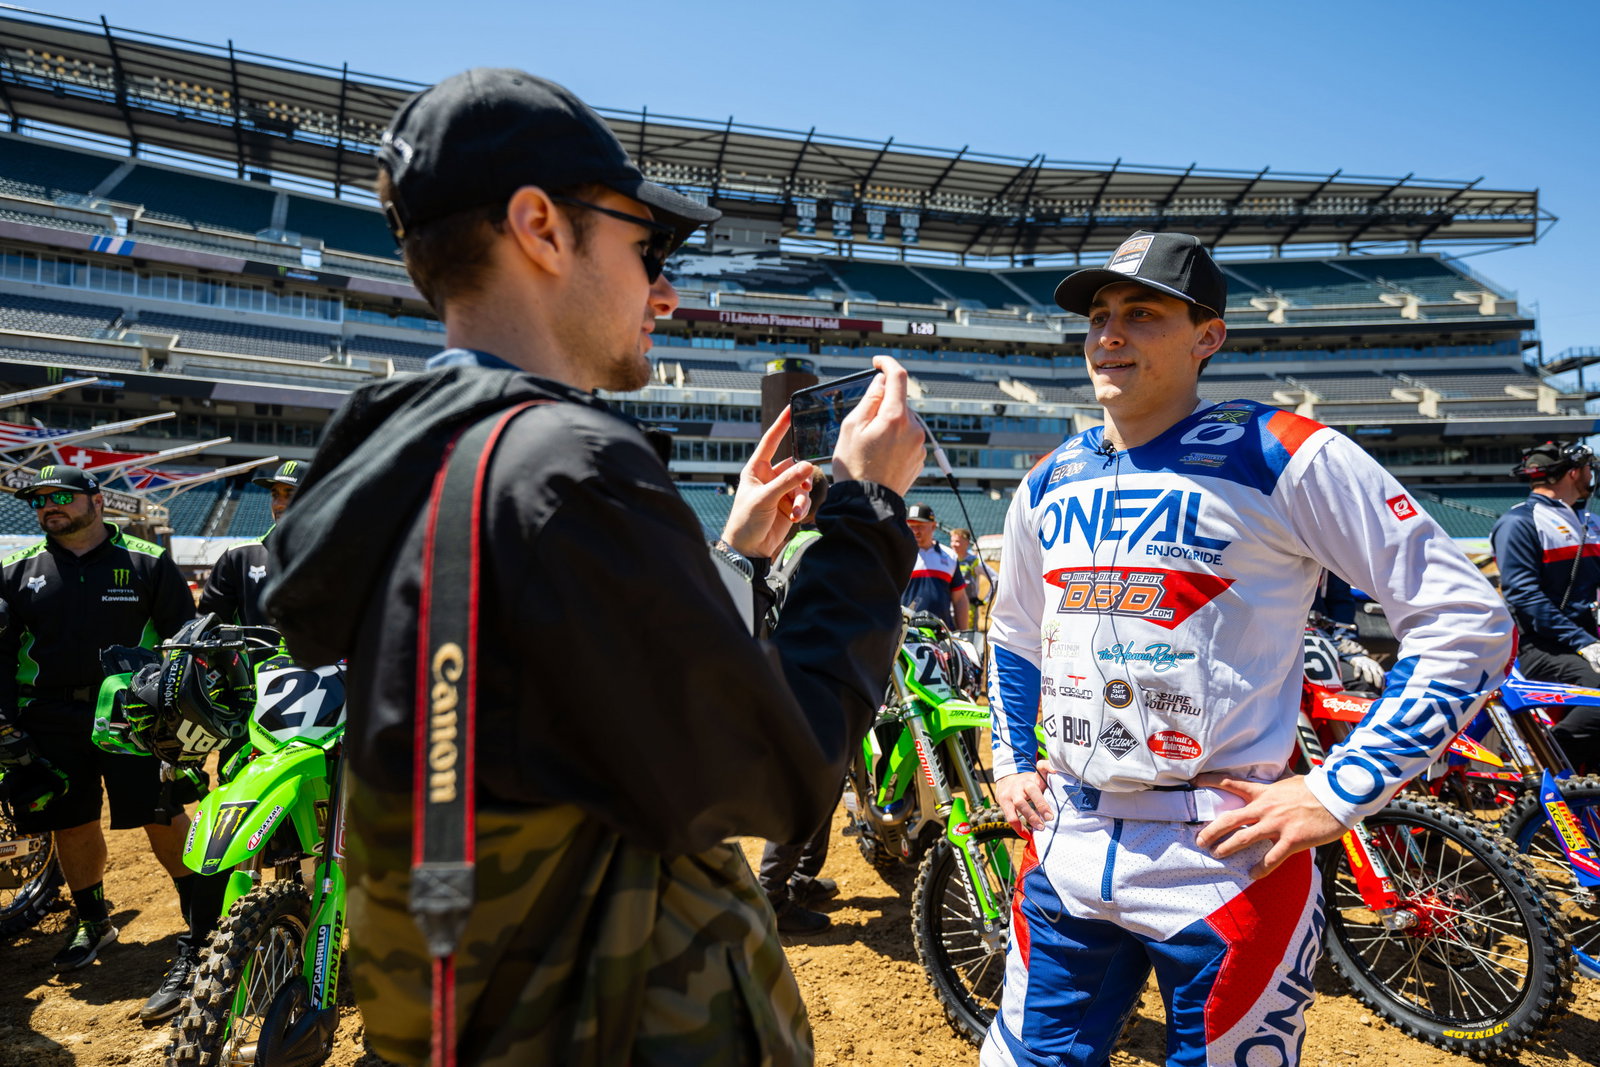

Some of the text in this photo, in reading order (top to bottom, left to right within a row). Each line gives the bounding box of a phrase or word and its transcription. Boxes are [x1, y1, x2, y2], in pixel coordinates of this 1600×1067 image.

[731, 312, 840, 330] Lincoln Financial Field
[127, 539, 155, 552] FOX
[1145, 544, 1189, 560] ENJOY
[1073, 573, 1090, 581] DIRT
[1098, 573, 1119, 581] BIKE
[1130, 574, 1164, 584] DEPOT
[1063, 584, 1160, 611] DBD
[164, 658, 180, 707] MONSTER
[258, 671, 346, 732] 21
[1160, 692, 1192, 705] PURE
[1149, 701, 1202, 716] OUTLAW
[429, 642, 464, 803] Canon
[1154, 733, 1193, 745] Marshall's
[1162, 740, 1199, 755] Motorsports
[915, 740, 936, 786] SHOWA
[970, 821, 1012, 833] DUNLO
[1547, 803, 1576, 849] ACERBIS
[952, 847, 981, 918] DUNLOP
[314, 925, 327, 983] CARRILLO
[327, 910, 343, 1008] DUNLOP
[1442, 1022, 1504, 1040] DUNLOP
